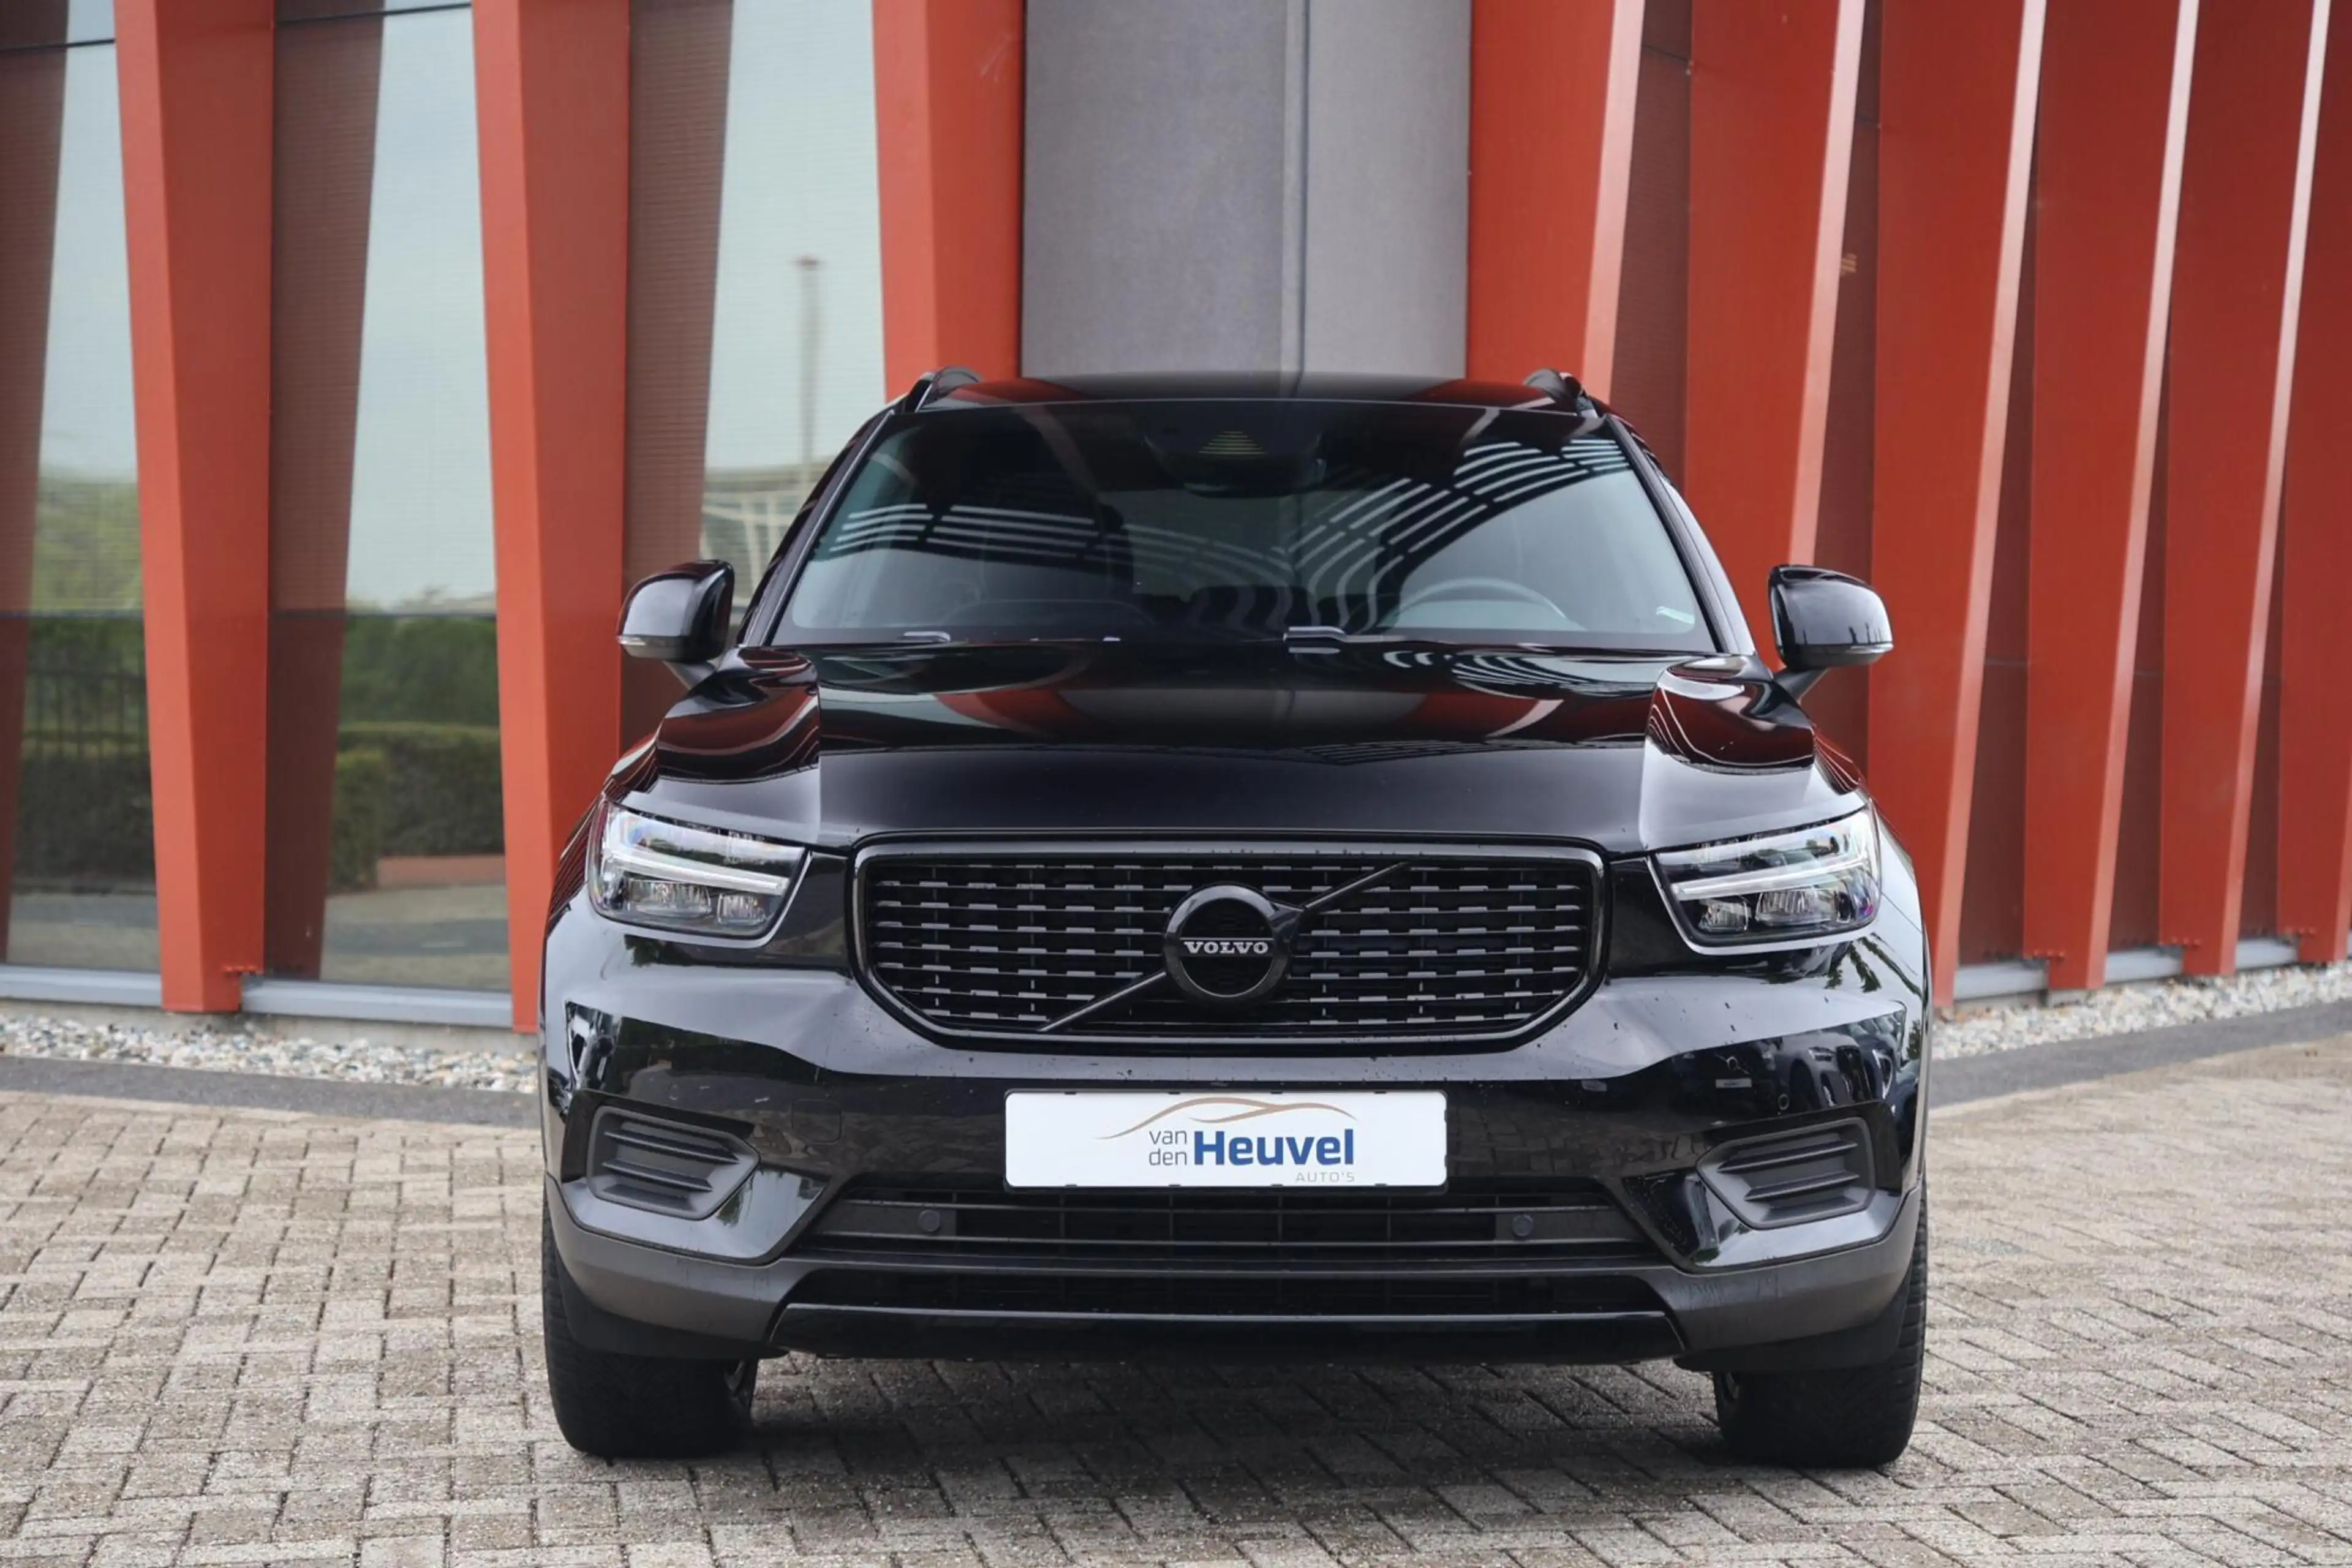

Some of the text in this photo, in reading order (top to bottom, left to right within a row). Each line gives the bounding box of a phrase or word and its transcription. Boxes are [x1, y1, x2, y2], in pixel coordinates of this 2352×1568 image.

[1183, 941, 1268, 954] VOLVO
[1149, 1130, 1187, 1145] van
[1148, 1129, 1354, 1166] den Heuvel
[1295, 1170, 1355, 1183] AUTO'S
